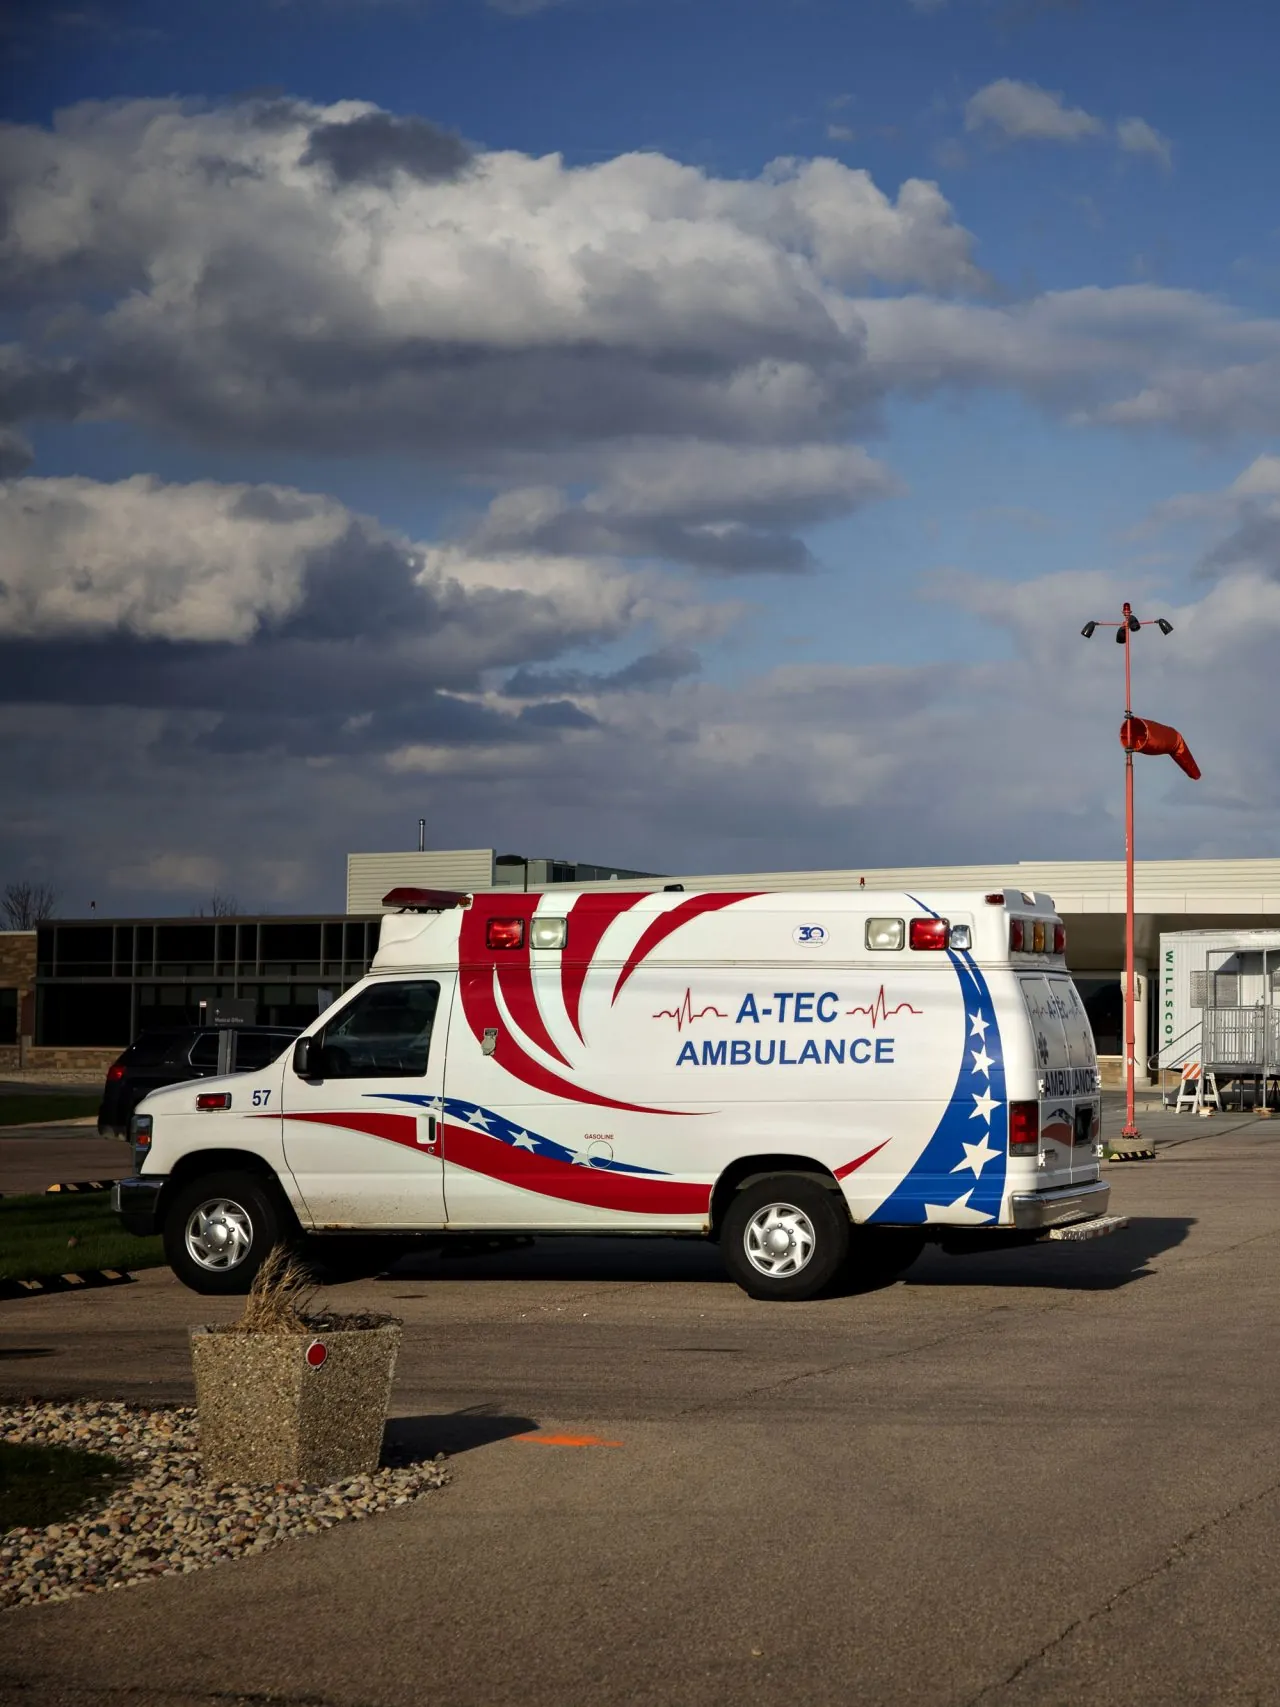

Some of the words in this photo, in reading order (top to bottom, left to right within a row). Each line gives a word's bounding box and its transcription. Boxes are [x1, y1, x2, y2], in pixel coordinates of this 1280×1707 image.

[735, 991, 839, 1024] A-TEC
[675, 1038, 895, 1066] AMBULANCE
[1045, 1068, 1097, 1097] AMBULANCE
[252, 1089, 272, 1106] 57
